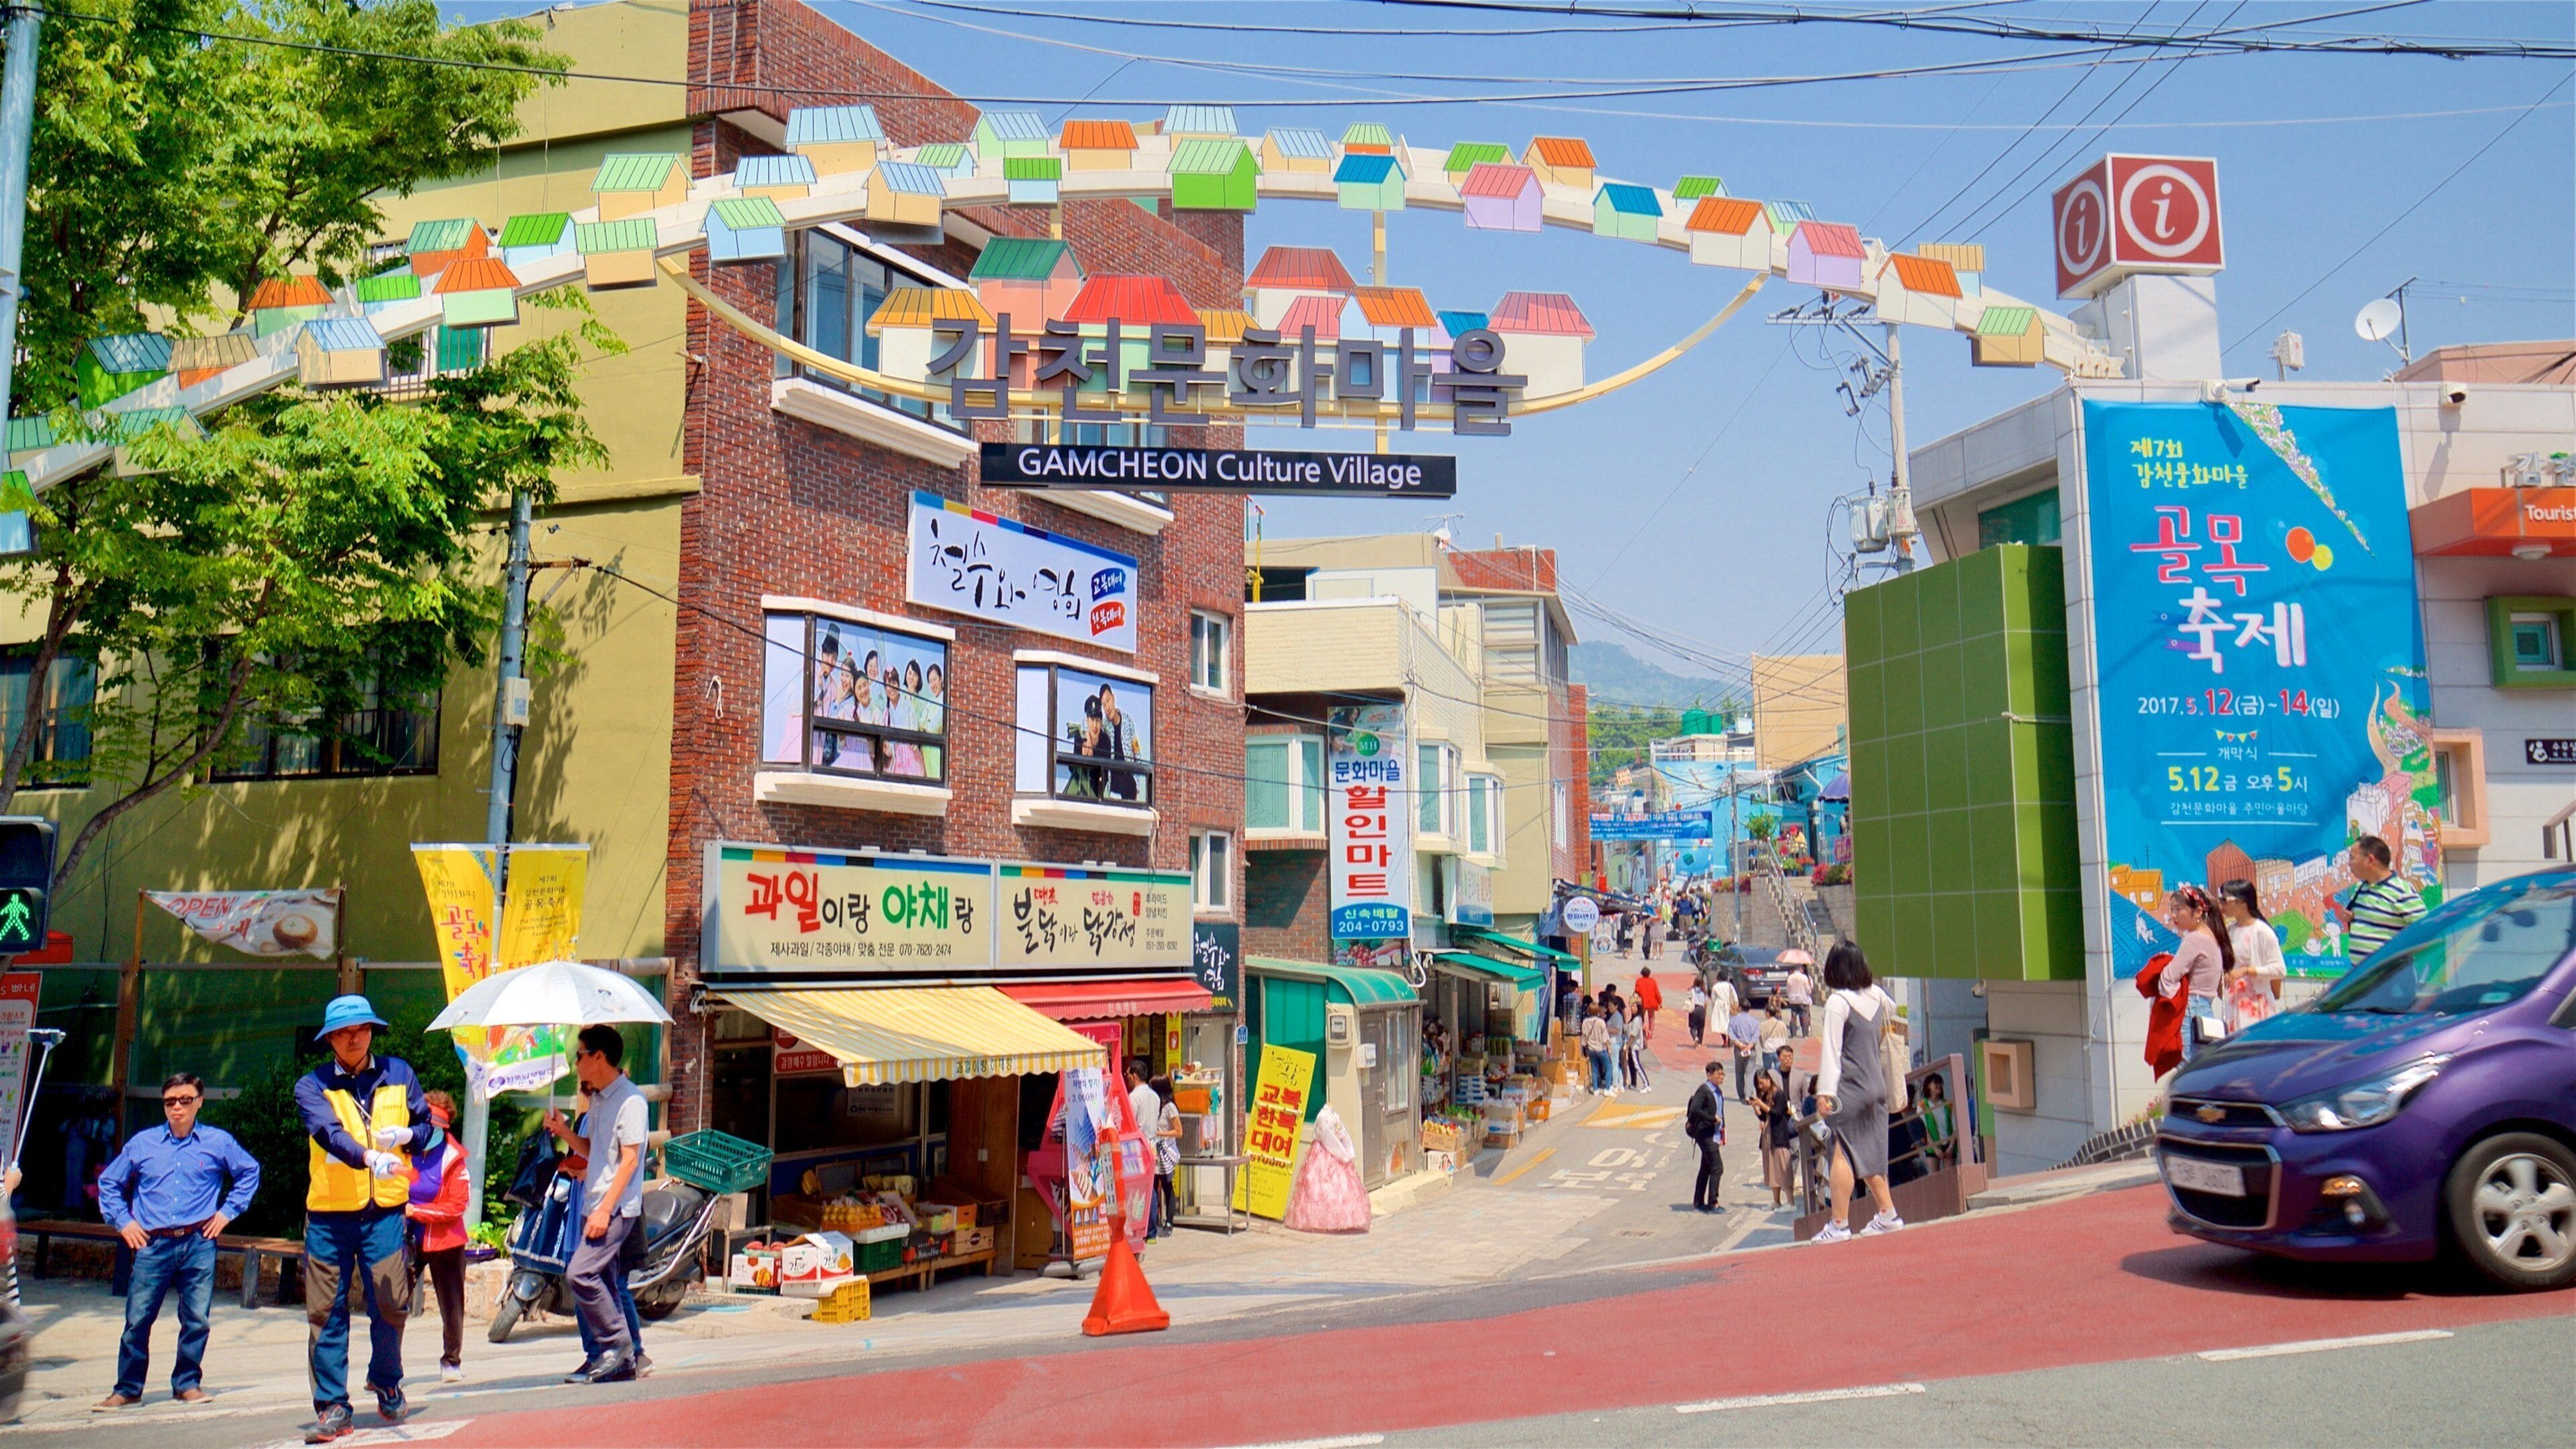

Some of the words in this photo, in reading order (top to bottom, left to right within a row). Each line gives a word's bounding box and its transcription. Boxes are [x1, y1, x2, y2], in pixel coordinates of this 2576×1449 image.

[927, 313, 1527, 436] 감천문화마을
[2130, 438, 2183, 460] 제7회
[1018, 446, 1208, 481] GAMCHEON
[1216, 453, 1320, 484] Culture
[1328, 457, 1421, 490] Village
[2133, 463, 2249, 489] 감천문화마을
[2129, 504, 2270, 596] 골목
[930, 519, 1026, 608] 철수와
[1033, 568, 1081, 620] 영희
[1093, 572, 1123, 594] 교복대여
[1091, 607, 1122, 630] 한복대여
[2177, 587, 2308, 675] 축제
[2218, 747, 2258, 761] 개막식
[1335, 759, 1400, 783] 문화마을
[2170, 802, 2238, 816] 감천문화마을
[1344, 786, 1393, 897] 할인마트
[1146, 894, 1167, 905] 후라이드
[1344, 908, 1399, 919] 신속배달
[1338, 920, 1405, 933] 204-0793
[899, 943, 951, 957] 070-7620-2474
[1258, 1083, 1302, 1112] 교복
[1256, 1106, 1298, 1135] 한복
[1250, 1130, 1293, 1158] 대여
